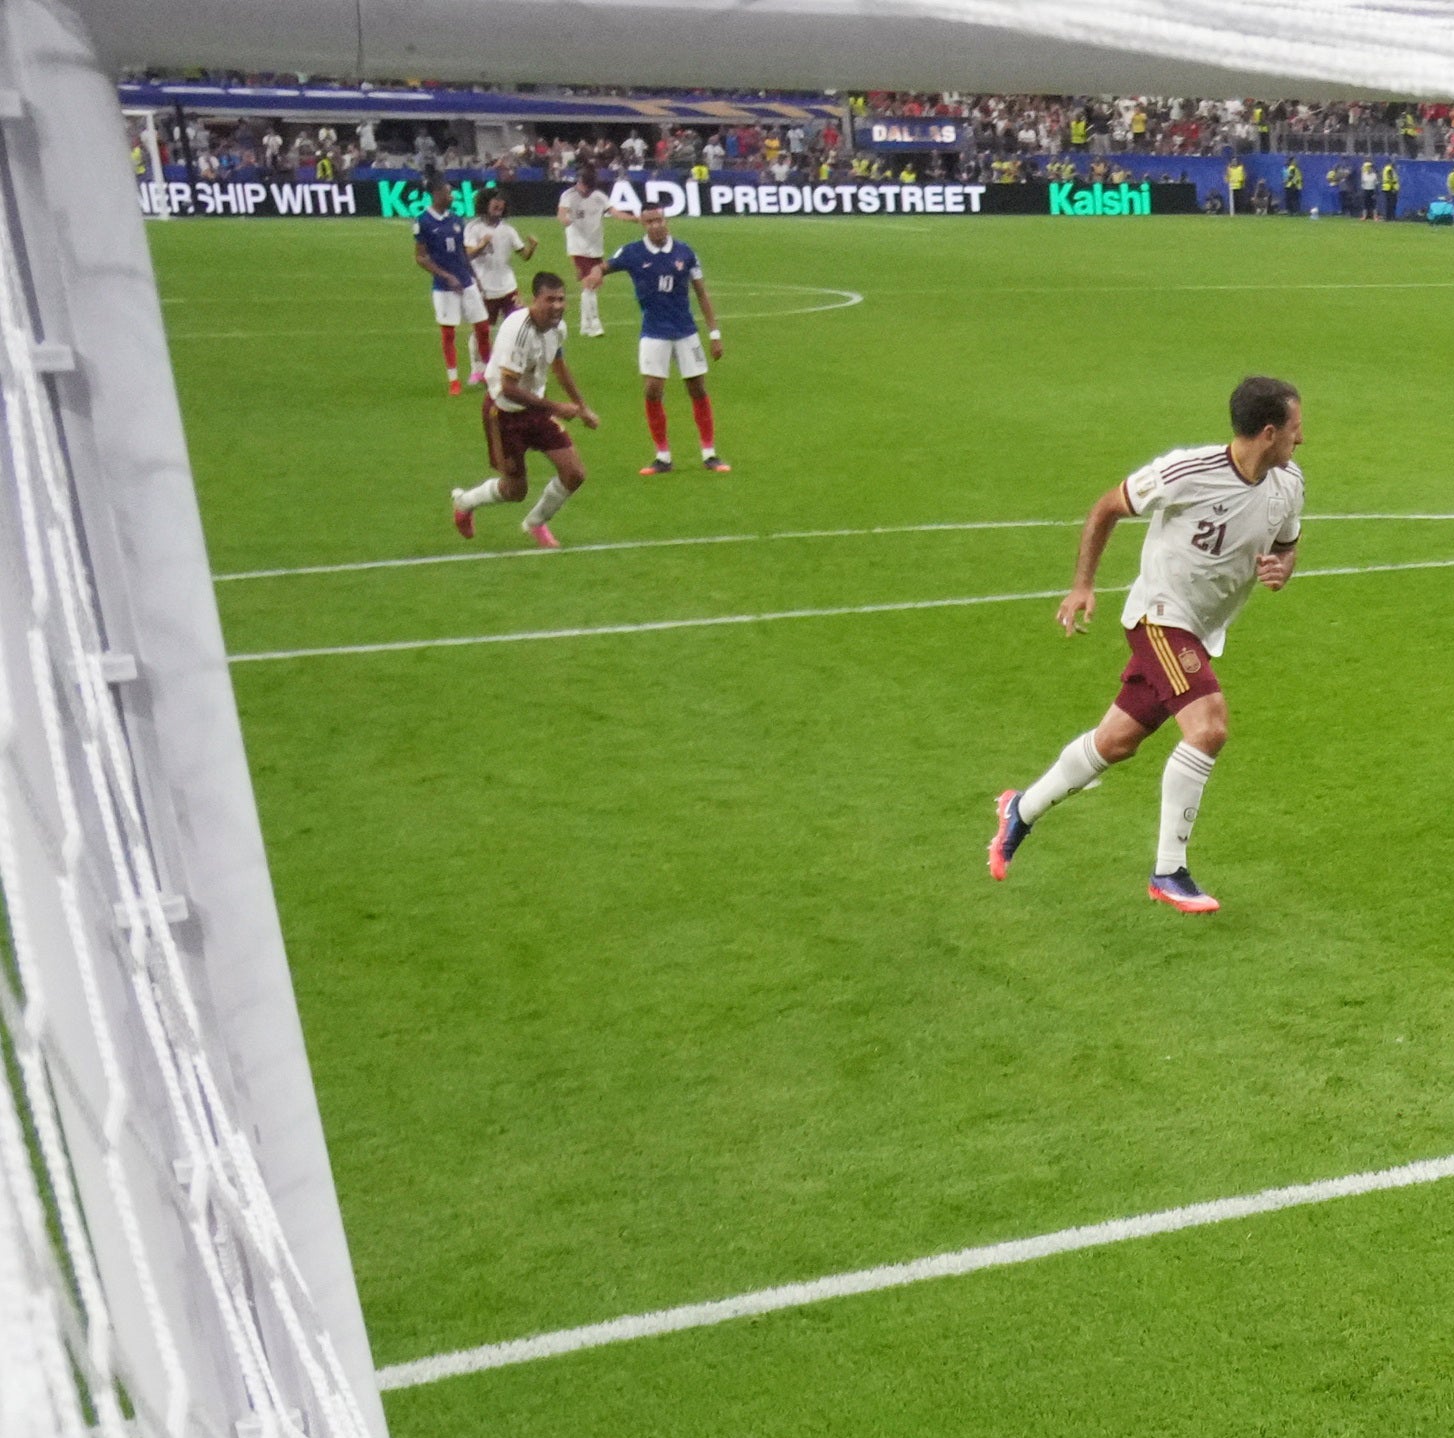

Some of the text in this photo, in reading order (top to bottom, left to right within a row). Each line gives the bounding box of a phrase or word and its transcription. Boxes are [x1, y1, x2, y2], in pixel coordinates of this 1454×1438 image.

[271, 183, 356, 215] WITH
[605, 180, 987, 217] ADI PREDICTSTREET
[1049, 182, 1151, 216] Kalshi
[658, 274, 674, 293] 10
[1191, 519, 1228, 556] 21
